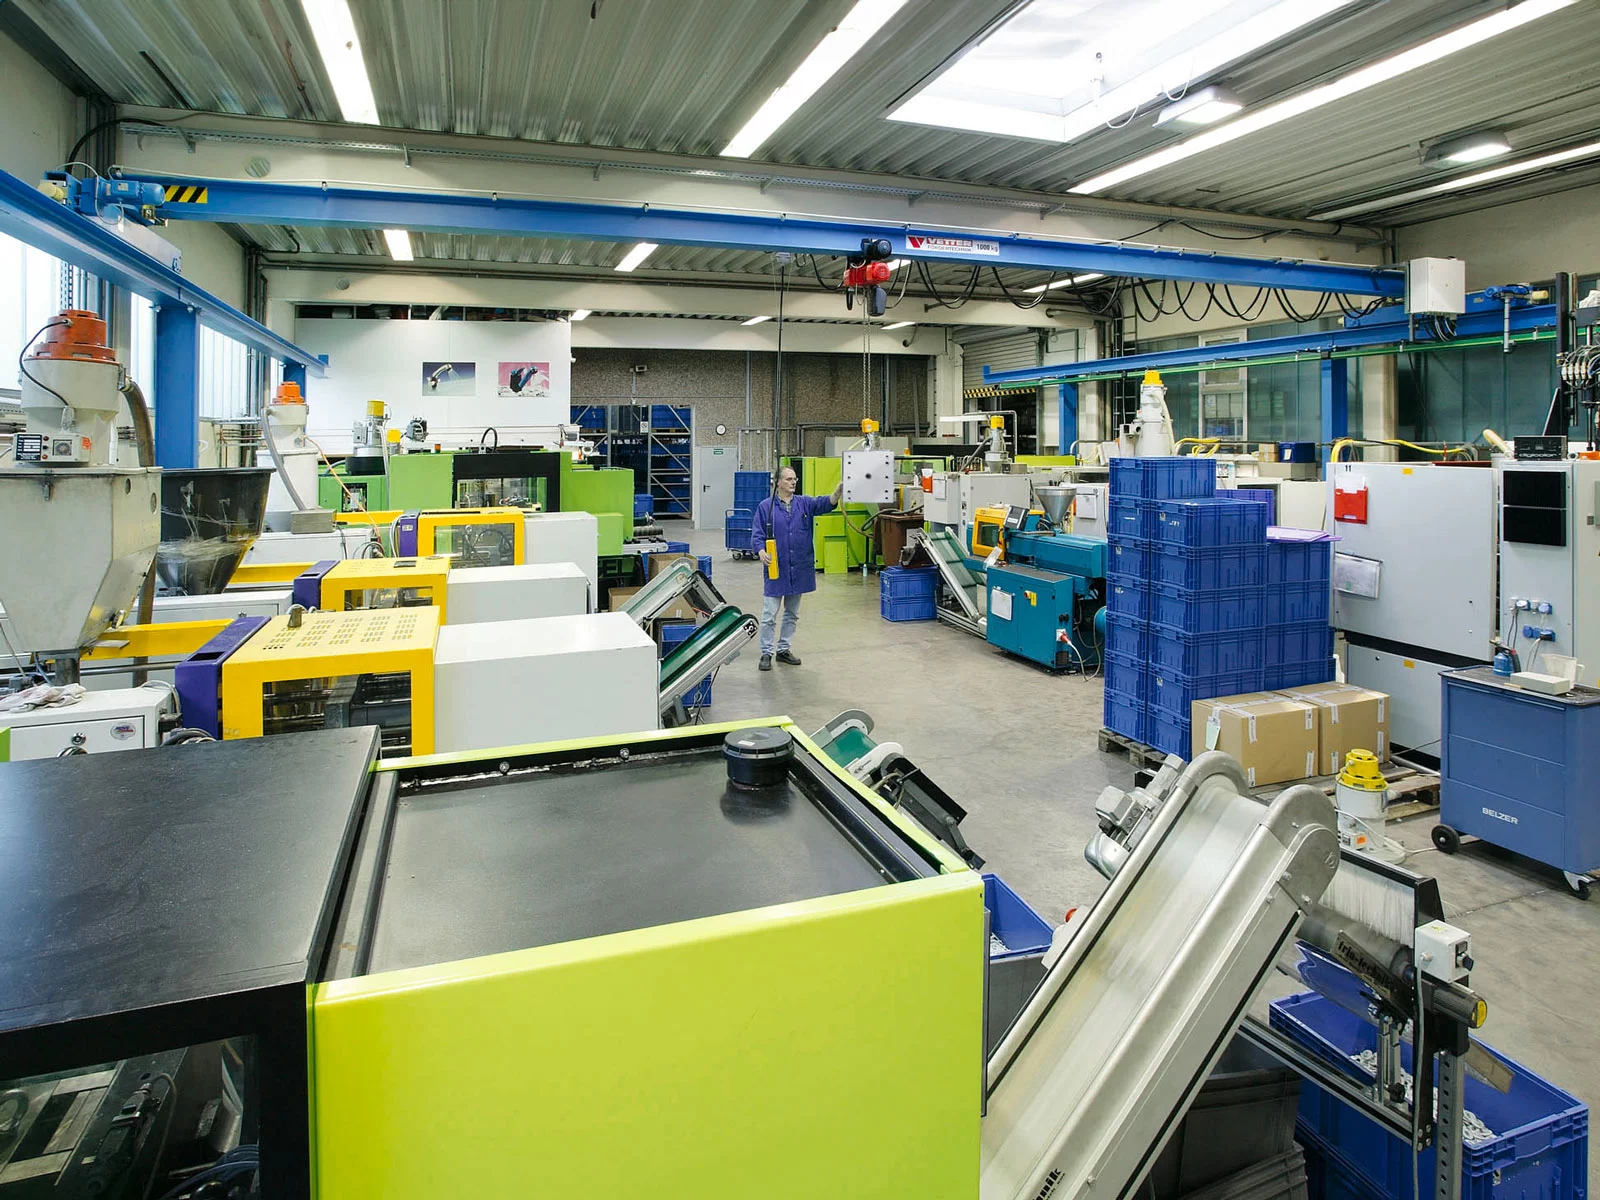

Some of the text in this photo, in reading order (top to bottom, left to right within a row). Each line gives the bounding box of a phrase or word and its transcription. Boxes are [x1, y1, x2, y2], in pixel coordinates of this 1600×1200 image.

[927, 236, 998, 253] VETTER 1000 kg
[1345, 464, 1351, 472] 11
[1482, 807, 1518, 824] BELZER
